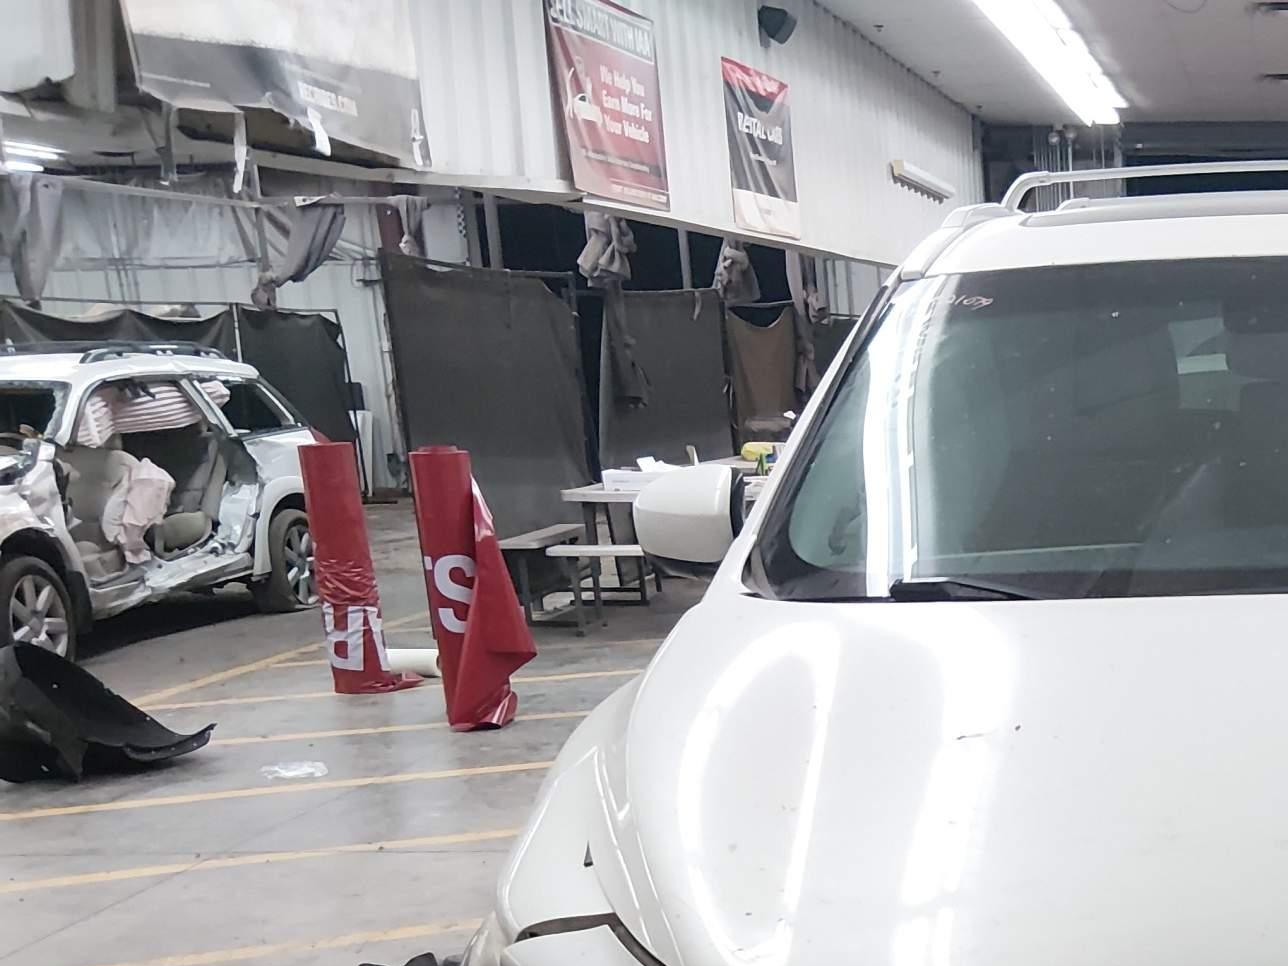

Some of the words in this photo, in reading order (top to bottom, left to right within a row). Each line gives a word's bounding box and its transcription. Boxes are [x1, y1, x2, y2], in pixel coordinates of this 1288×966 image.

[600, 64, 613, 85] We
[613, 69, 632, 95] Help
[630, 75, 645, 97] You
[602, 89, 621, 110] Earn
[620, 95, 640, 118] More
[640, 102, 653, 121] For
[603, 113, 622, 135] Your
[622, 119, 650, 144] Vehicle
